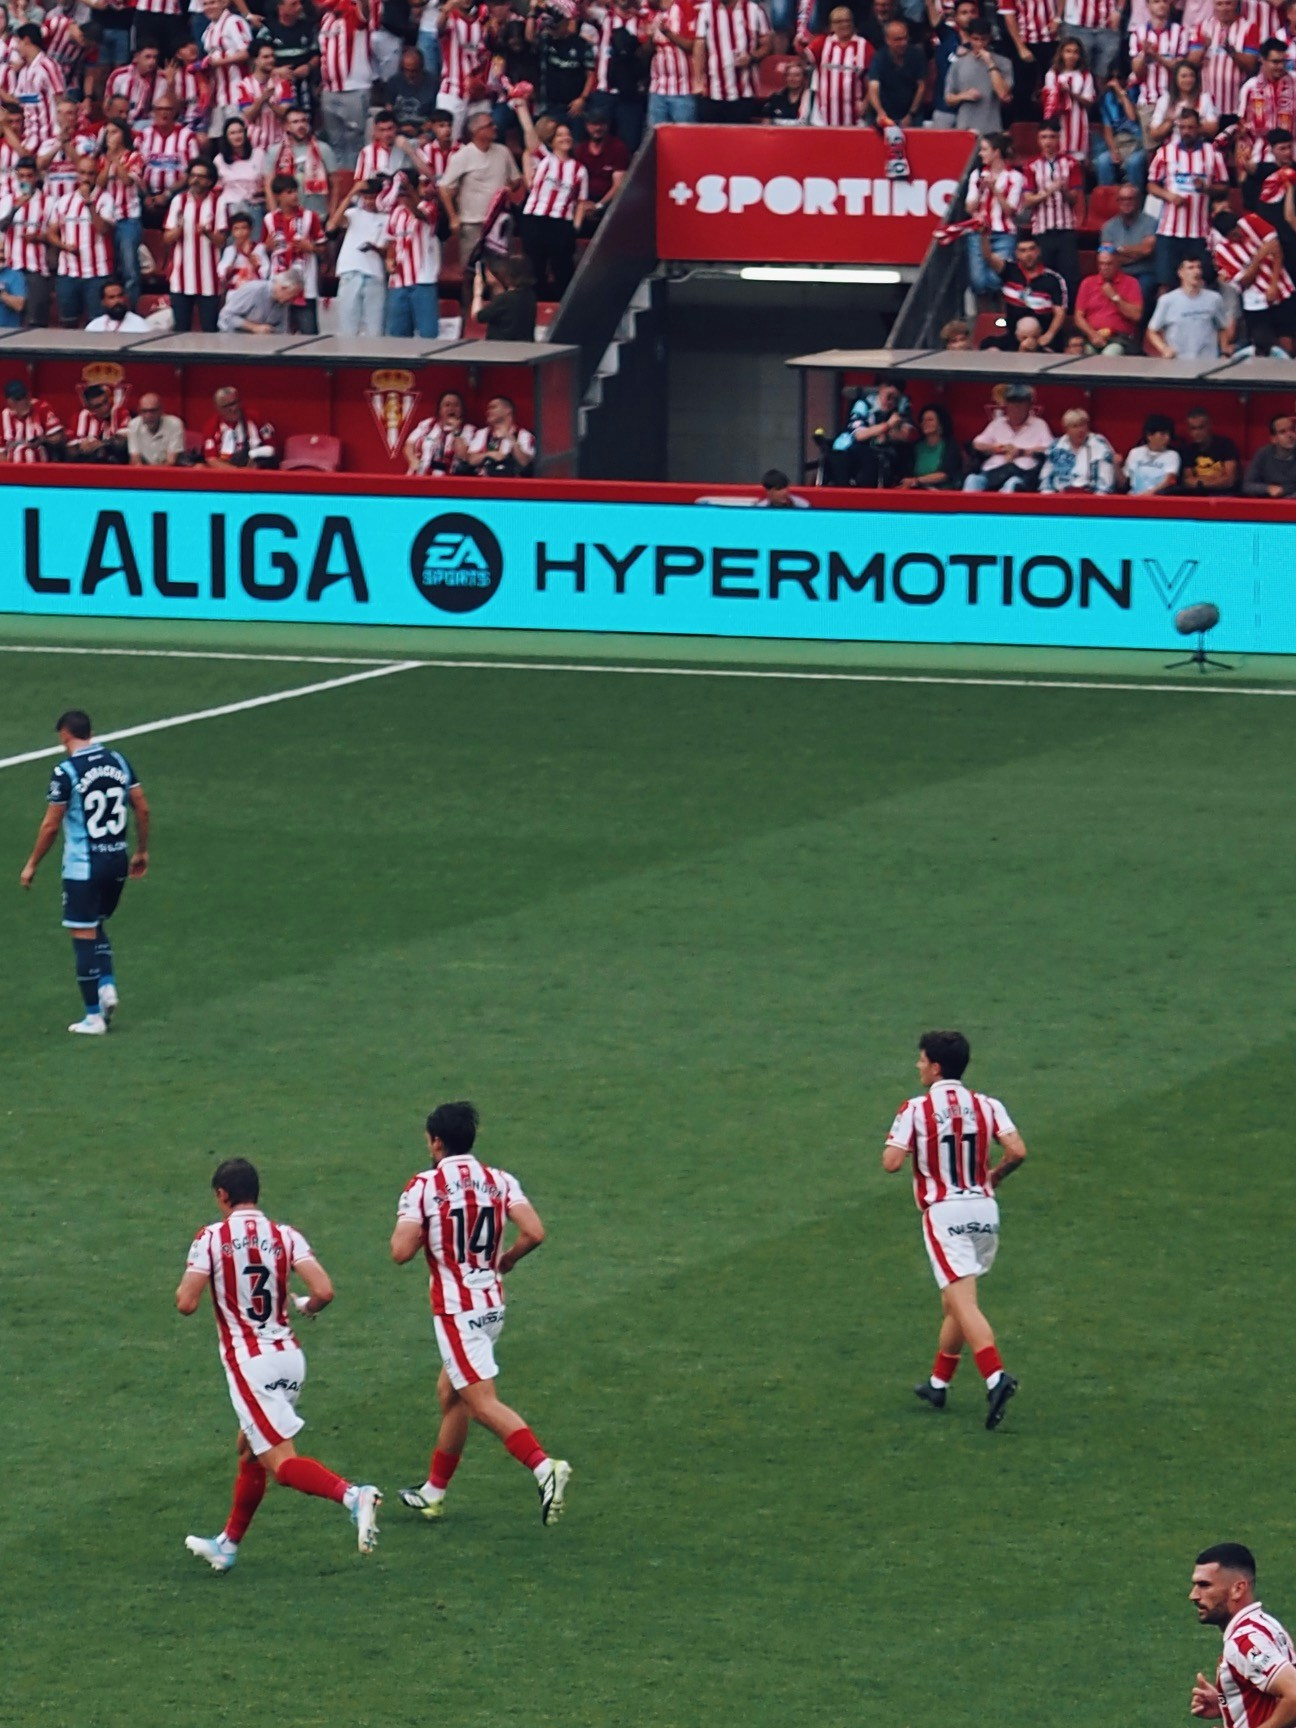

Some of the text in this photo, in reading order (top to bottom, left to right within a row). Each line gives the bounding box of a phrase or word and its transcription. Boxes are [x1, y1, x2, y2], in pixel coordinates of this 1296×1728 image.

[24, 507, 370, 602] LALIGA
[421, 569, 492, 588] SPORTS
[423, 532, 486, 569] EA
[535, 541, 1132, 609] HYPERMOTION
[84, 786, 128, 839] 23
[941, 1133, 977, 1187] 11
[449, 1206, 496, 1264] 14
[242, 1265, 273, 1323] 3
